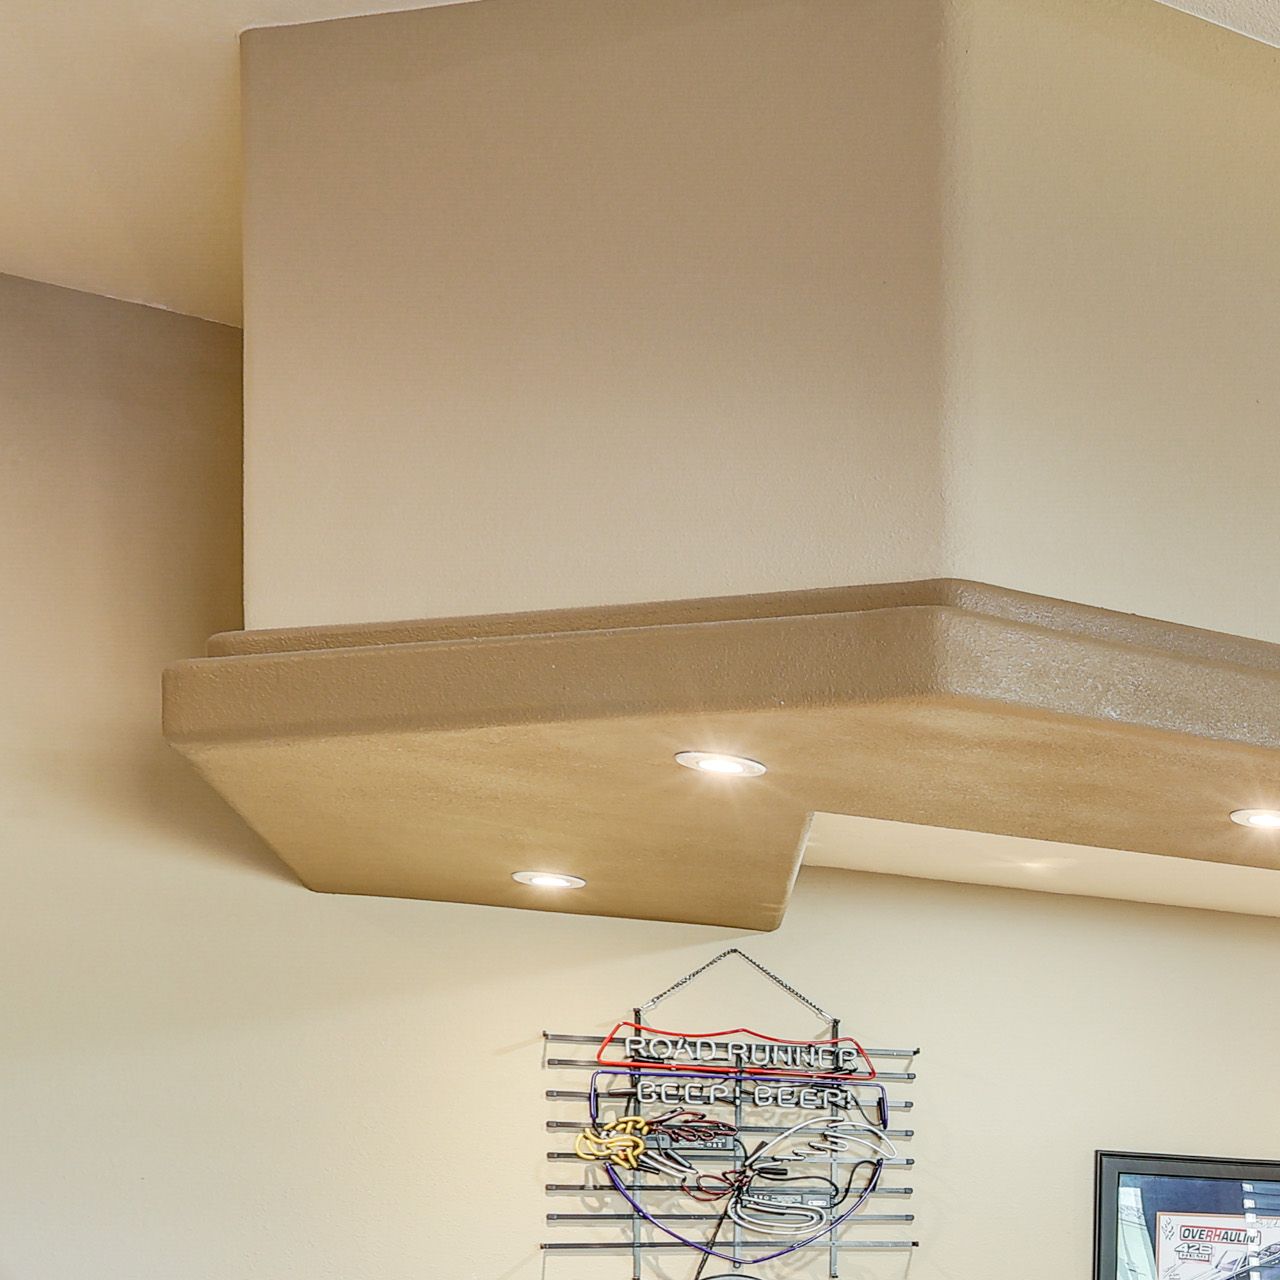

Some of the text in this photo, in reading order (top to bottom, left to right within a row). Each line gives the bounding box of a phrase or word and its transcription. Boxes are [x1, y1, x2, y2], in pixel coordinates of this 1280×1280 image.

[625, 1036, 858, 1068] ROAD RUNNER
[636, 1081, 852, 1109] BEEP! BEEP!
